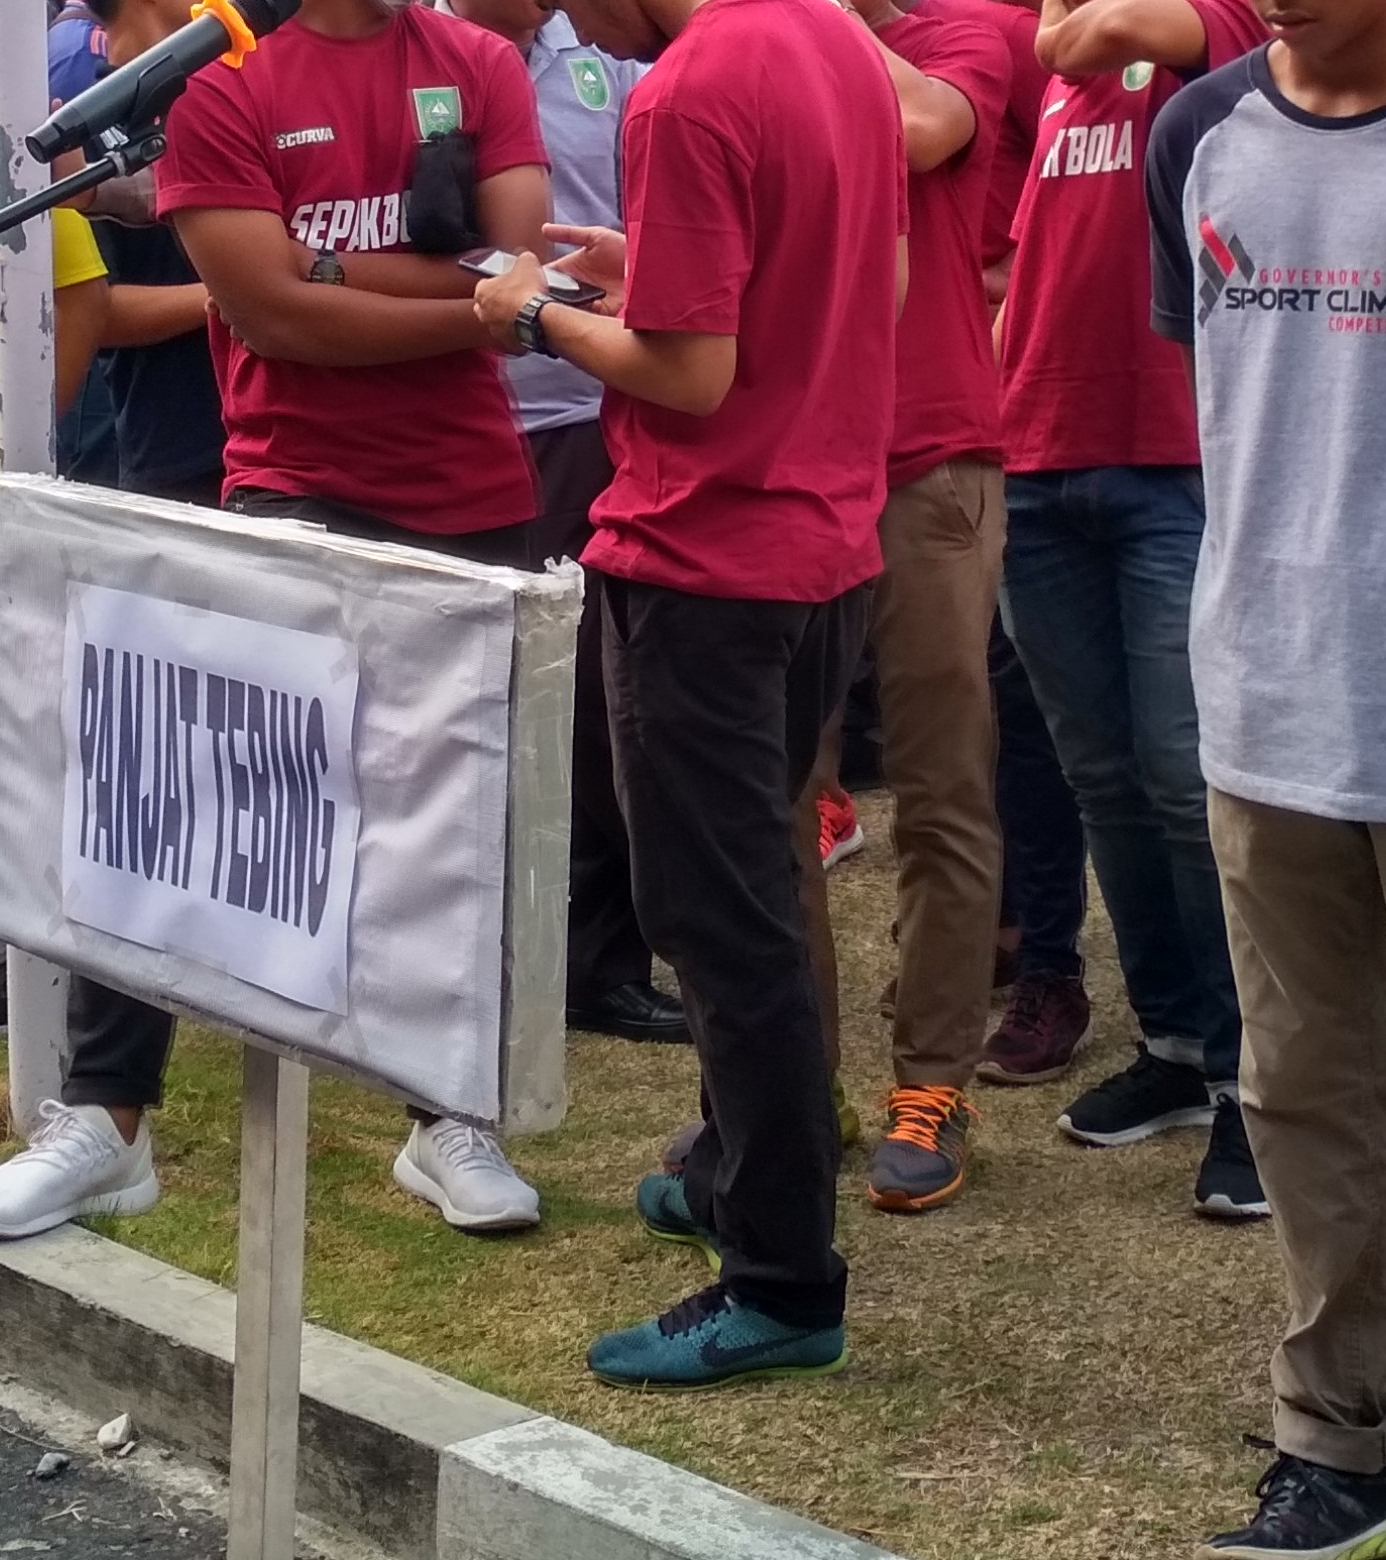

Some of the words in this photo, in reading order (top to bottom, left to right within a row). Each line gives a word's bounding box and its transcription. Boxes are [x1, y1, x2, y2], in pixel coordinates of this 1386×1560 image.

[1040, 119, 1133, 178] KBOLA
[291, 190, 412, 251] SEPAKBO
[1225, 286, 1321, 312] SPORT
[1258, 267, 1382, 288] GOVERNOR'S
[79, 642, 199, 891] PANJAT
[206, 672, 335, 938] TEBING
